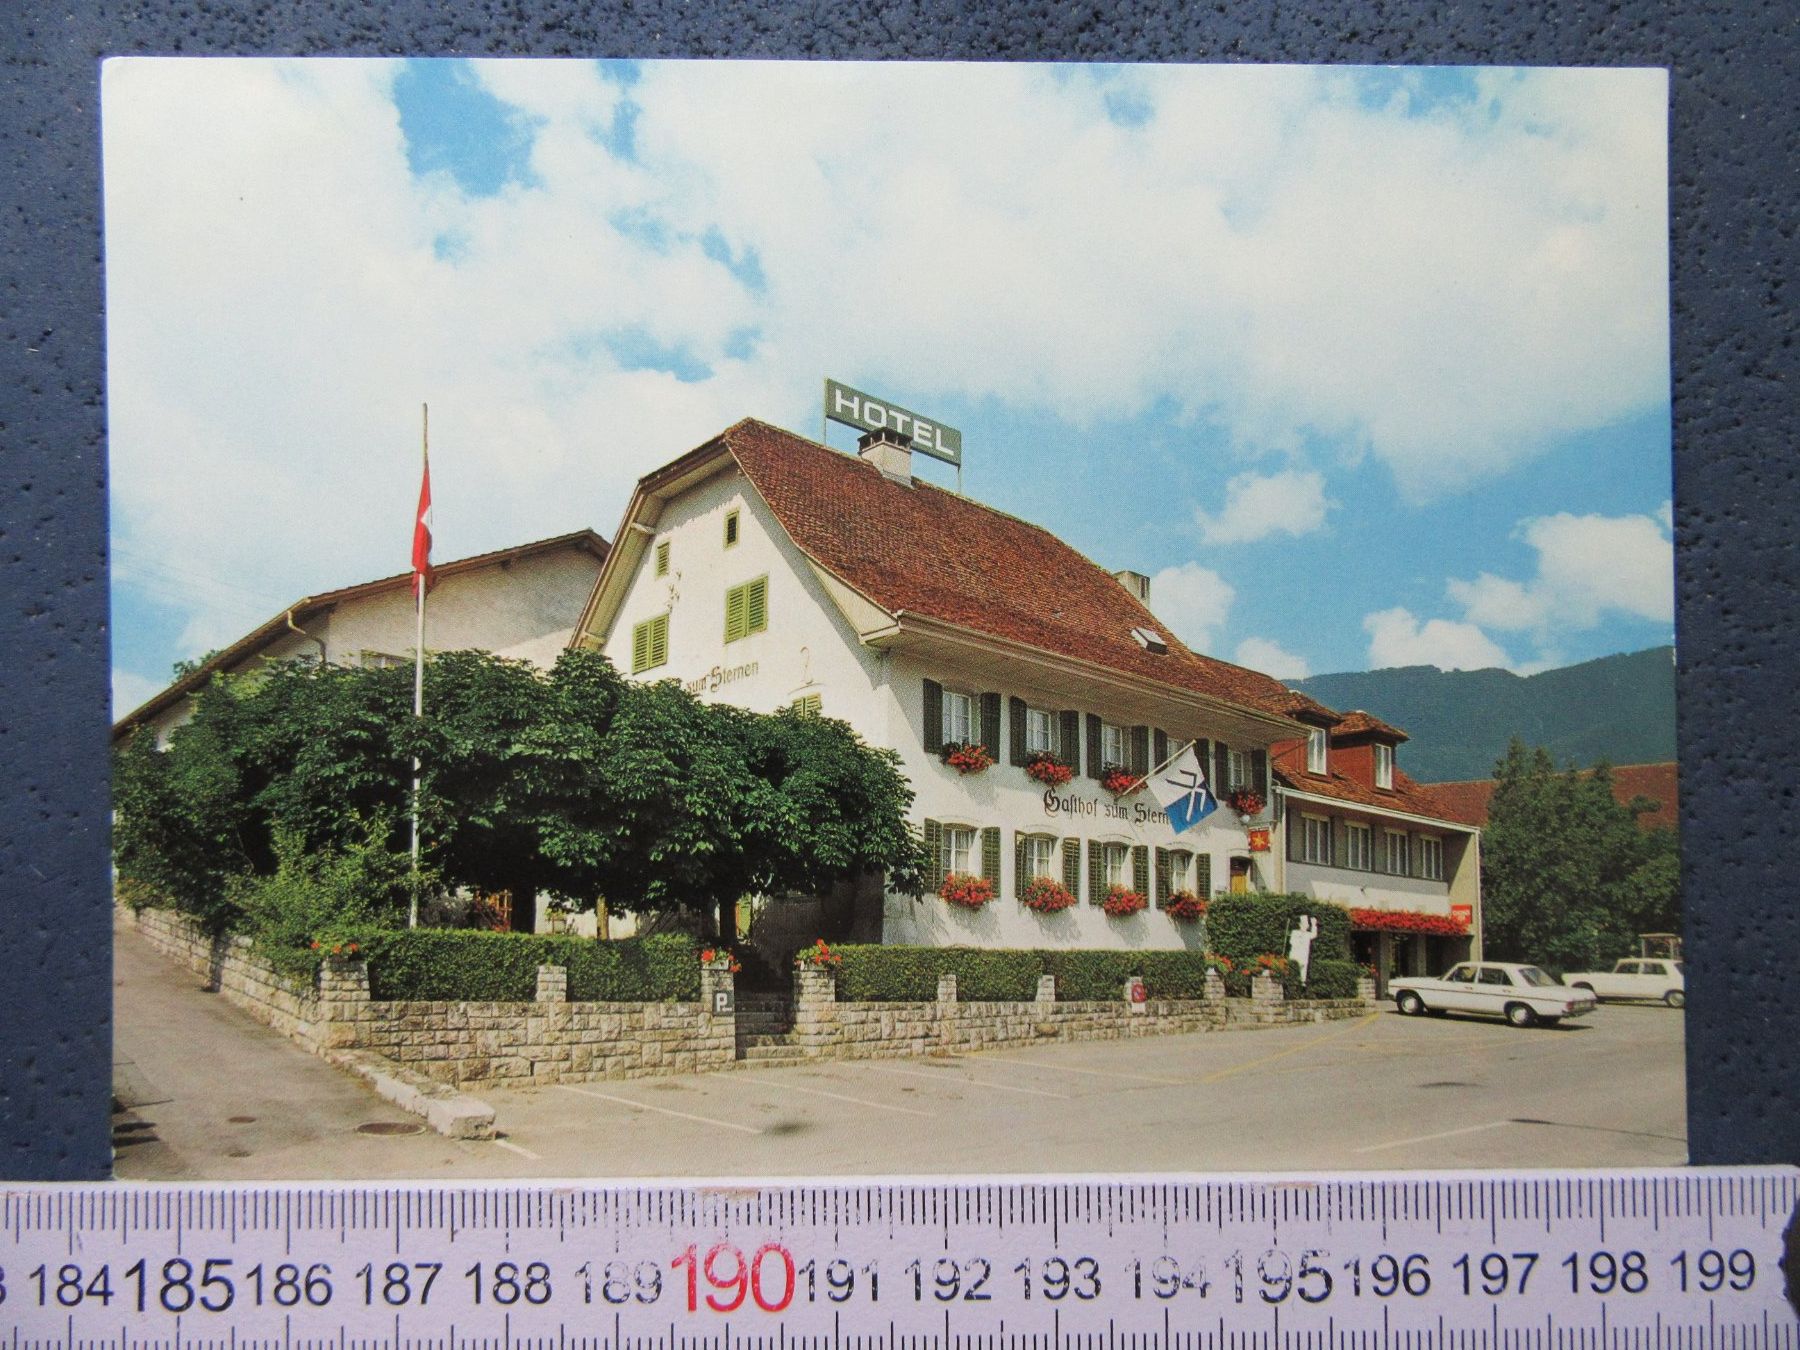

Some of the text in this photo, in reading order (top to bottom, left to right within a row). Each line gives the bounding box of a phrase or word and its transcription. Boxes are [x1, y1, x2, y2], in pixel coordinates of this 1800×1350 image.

[835, 388, 955, 456] HOTEL
[710, 660, 759, 693] Sternen
[1134, 802, 1170, 828] Stern
[716, 992, 728, 1012] P
[29, 1263, 114, 1306] 184
[124, 1258, 235, 1313] 185
[246, 1263, 333, 1306] 186
[355, 1262, 443, 1305] 187
[464, 1261, 553, 1305] 188
[575, 1260, 663, 1304] 189
[671, 1242, 796, 1312] 190
[798, 1258, 879, 1302] 191
[904, 1257, 992, 1302] 192
[1013, 1256, 1102, 1300] 193
[1124, 1255, 1212, 1299] 194
[1224, 1249, 1333, 1304] 195
[1343, 1253, 1431, 1298] 196
[1452, 1252, 1540, 1296] 197
[1561, 1250, 1649, 1294] 198
[1670, 1249, 1756, 1292] 199
